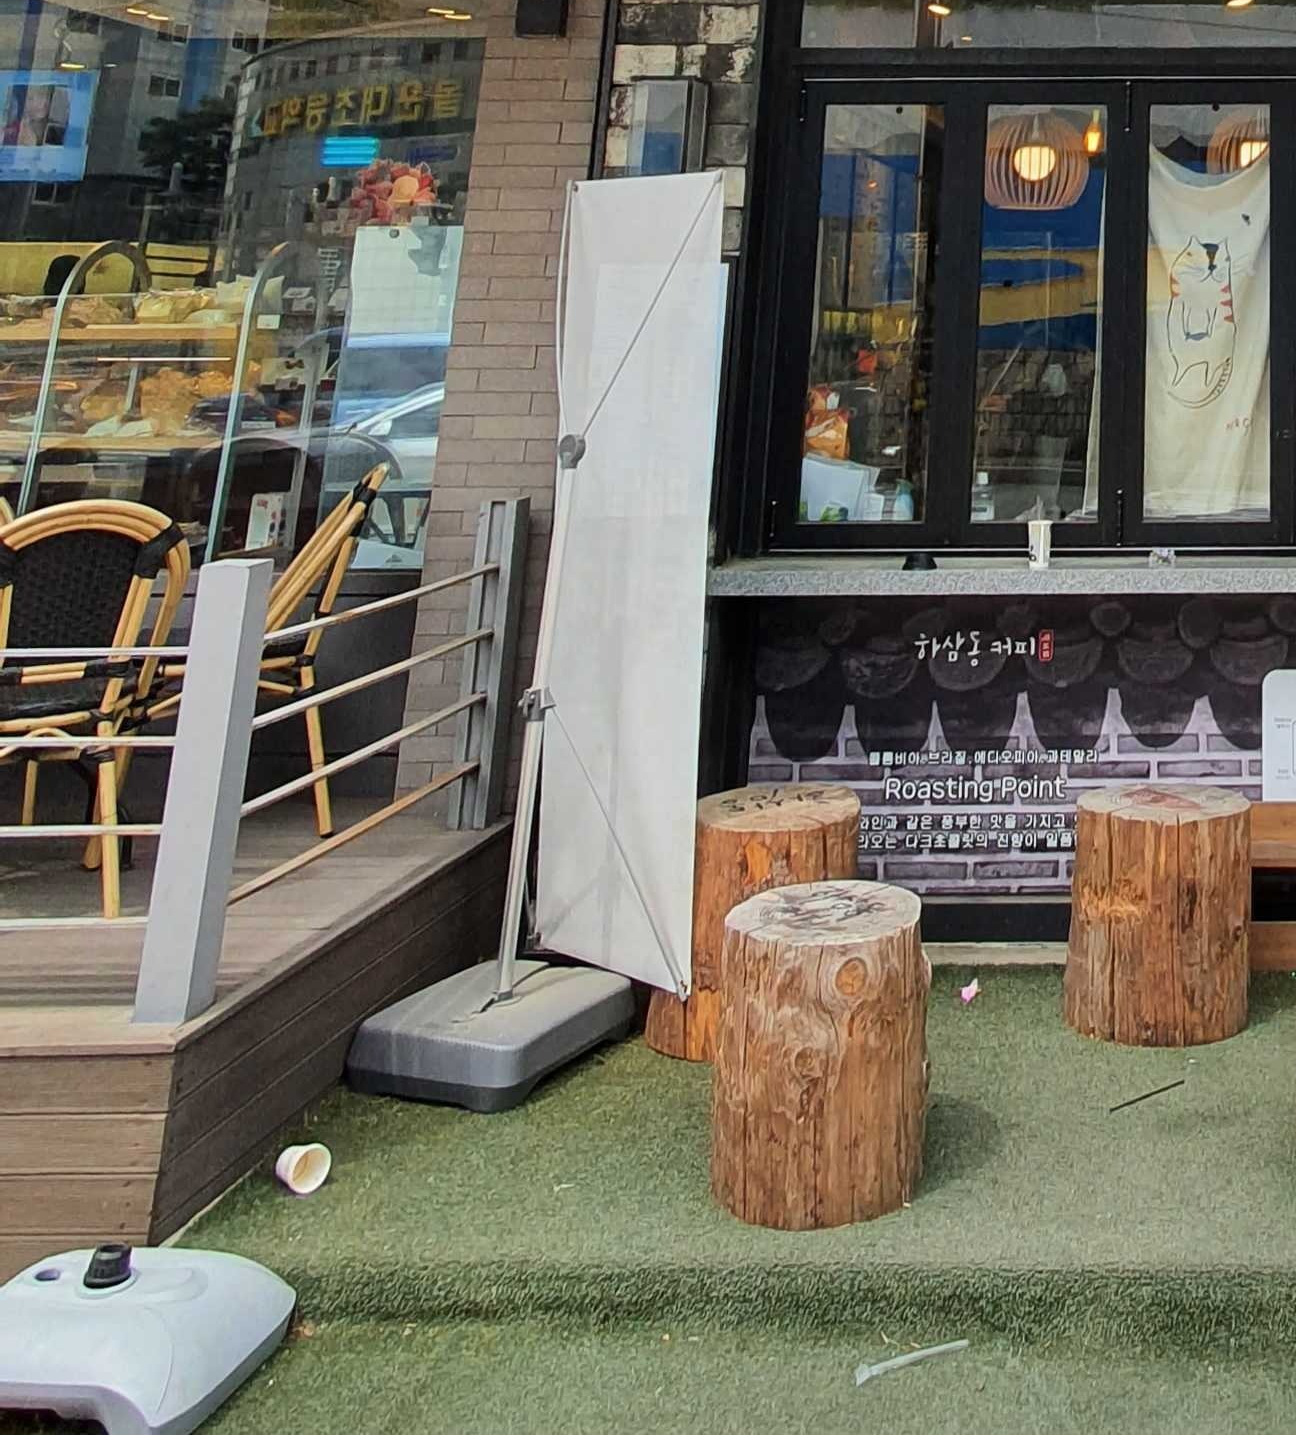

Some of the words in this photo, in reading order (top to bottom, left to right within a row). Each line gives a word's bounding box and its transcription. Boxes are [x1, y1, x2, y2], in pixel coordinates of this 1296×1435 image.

[914, 631, 981, 667] 하삼동
[990, 637, 1035, 656] 커피
[885, 776, 993, 802] Roasting
[1001, 776, 1066, 799] Point
[1025, 813, 1066, 829] 가지고
[1046, 832, 1077, 848] 일품
